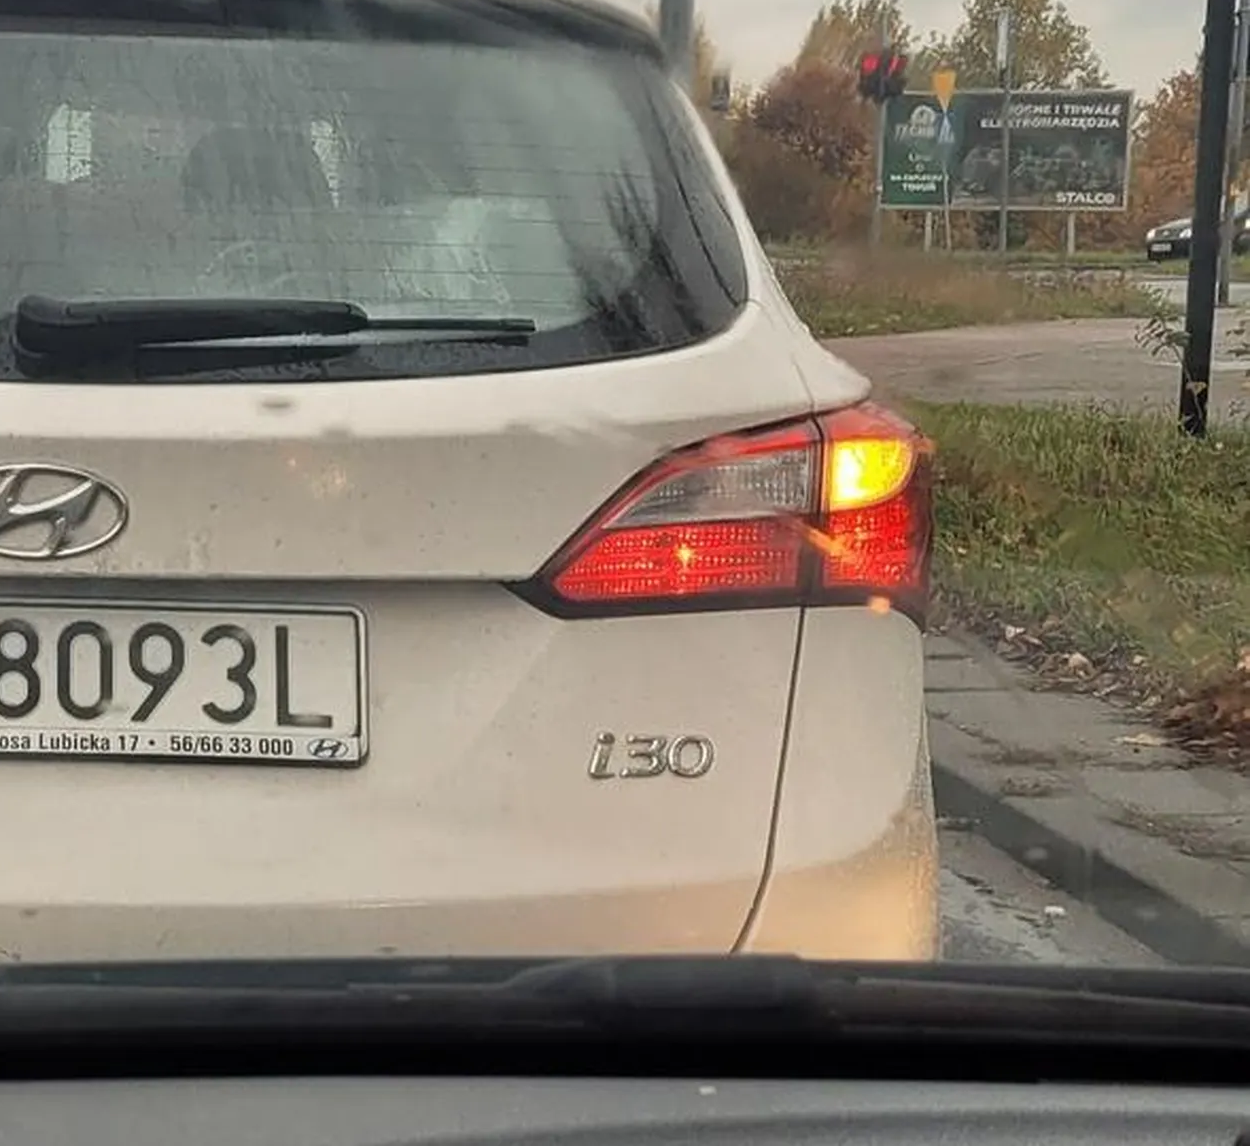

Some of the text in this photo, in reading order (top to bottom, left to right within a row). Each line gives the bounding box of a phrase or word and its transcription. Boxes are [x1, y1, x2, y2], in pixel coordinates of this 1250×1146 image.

[38, 733, 111, 751] Lubicka
[118, 735, 139, 751] 17
[170, 735, 223, 754] 56/66
[229, 736, 253, 753] 33
[259, 738, 294, 755] 000
[588, 732, 715, 780] i30
